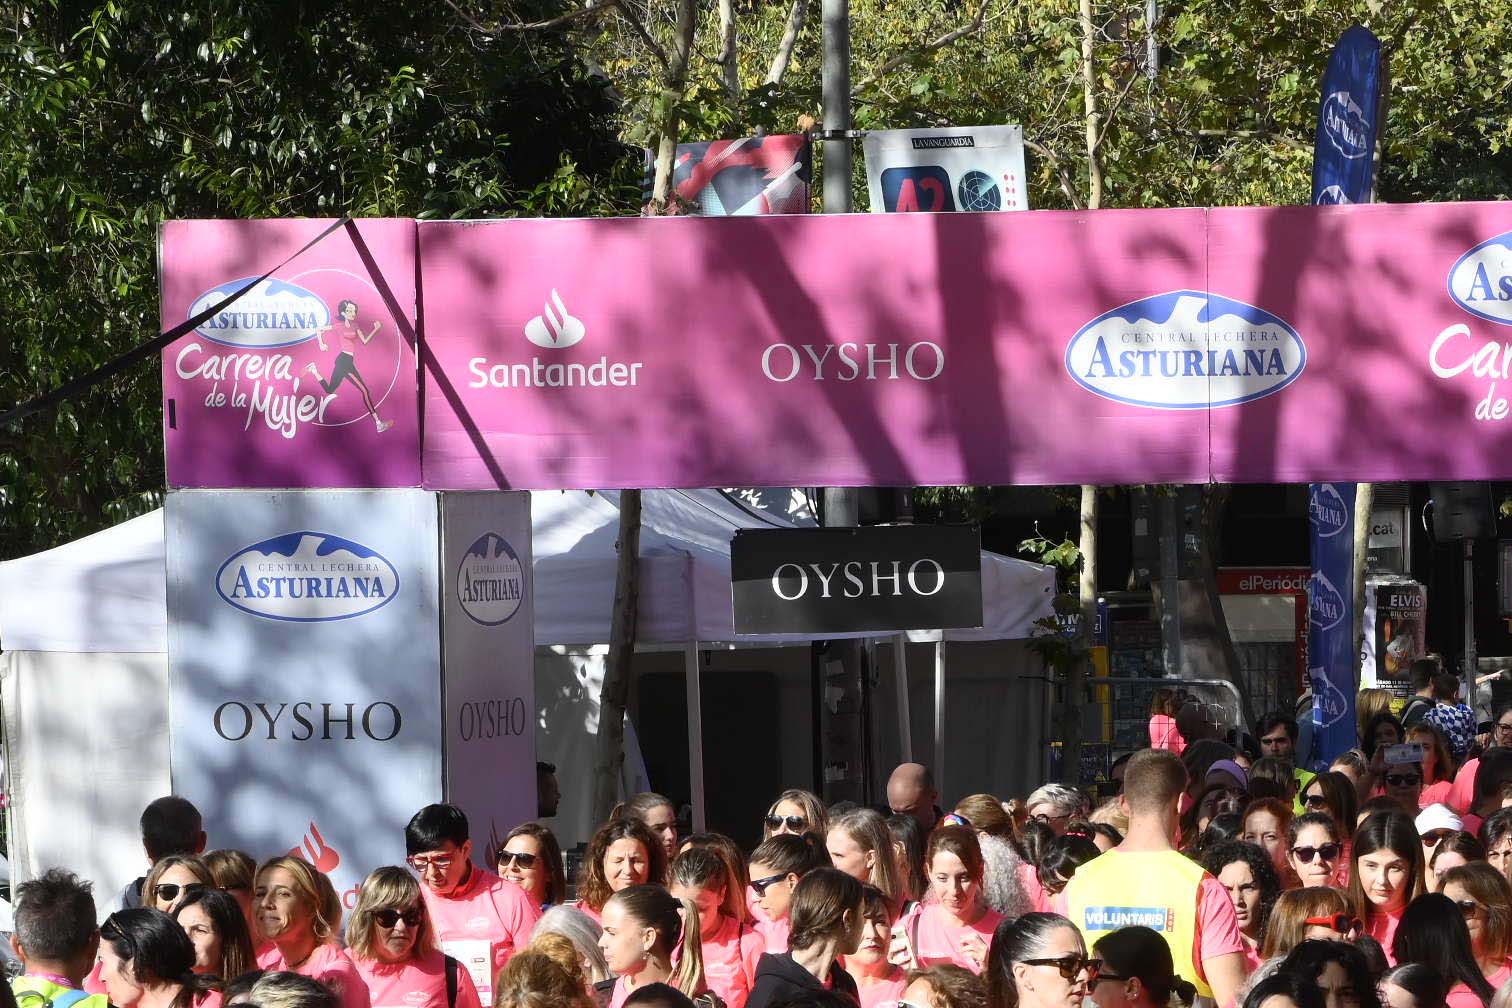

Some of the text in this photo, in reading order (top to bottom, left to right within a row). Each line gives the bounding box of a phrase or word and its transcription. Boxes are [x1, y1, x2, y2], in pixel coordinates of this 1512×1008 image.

[1084, 335, 1287, 378] ASTURIANA
[1121, 331, 1280, 347] CENTRAL LECHERA
[175, 342, 295, 382] Carrera
[469, 357, 643, 389] Santander
[761, 341, 945, 382] OYSHO
[204, 373, 338, 439] de la Mujer
[1475, 381, 1509, 421] de
[1370, 516, 1396, 534] .cat
[230, 565, 387, 599] ASTURIANA
[258, 563, 380, 572] CENTRAL LECHERA
[771, 558, 945, 601] OYSHO
[462, 574, 521, 603] ASTURIANA
[1390, 594, 1423, 607] ELVIS
[213, 701, 402, 742] OYSHO
[459, 697, 526, 742] OYSHO
[1085, 911, 1164, 927] VOLUNTARIS
